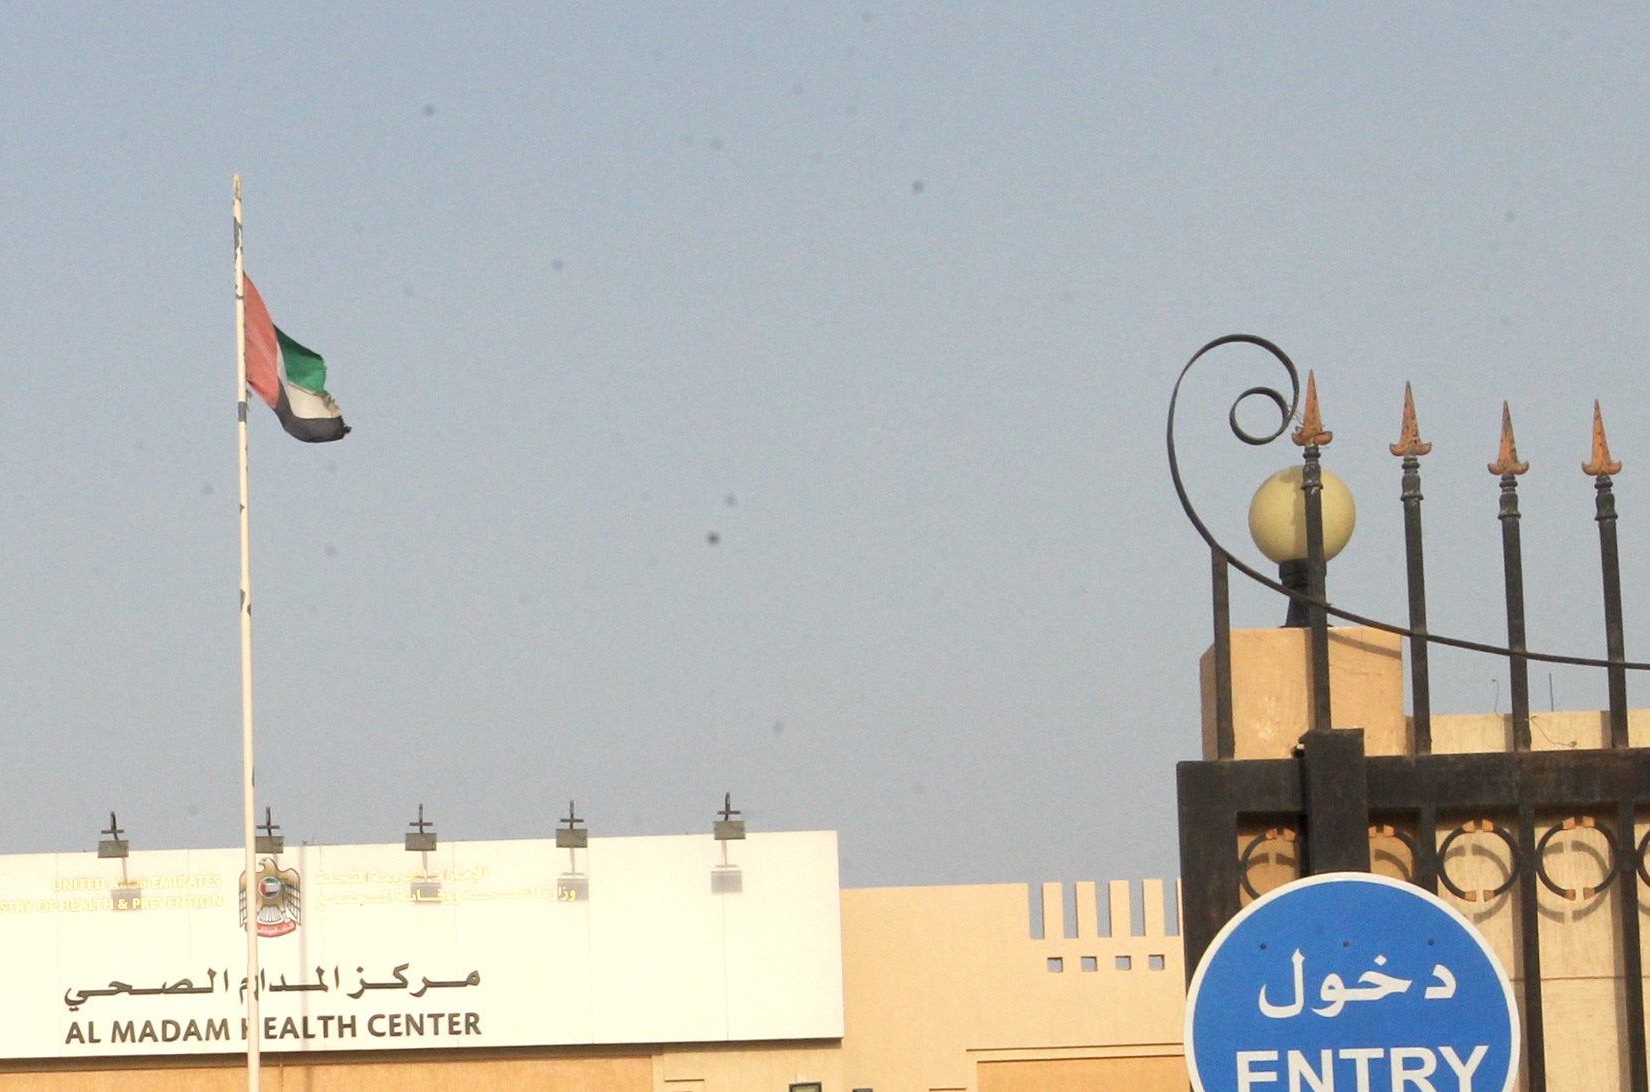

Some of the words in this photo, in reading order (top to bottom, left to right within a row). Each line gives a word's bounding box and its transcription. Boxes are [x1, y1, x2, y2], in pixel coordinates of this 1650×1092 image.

[51, 878, 106, 891] UNITED
[151, 875, 222, 889] EMIRATES
[36, 900, 56, 913] OF
[59, 898, 114, 912] HEALTH
[117, 898, 129, 910] &
[132, 894, 223, 910] PREVENTION
[64, 967, 229, 1012] الصحي
[346, 962, 481, 1000] مركز
[1258, 948, 1457, 1018] دخول
[65, 1020, 102, 1044] AL
[111, 1017, 230, 1043] MADAM
[367, 1012, 482, 1037] CENTER
